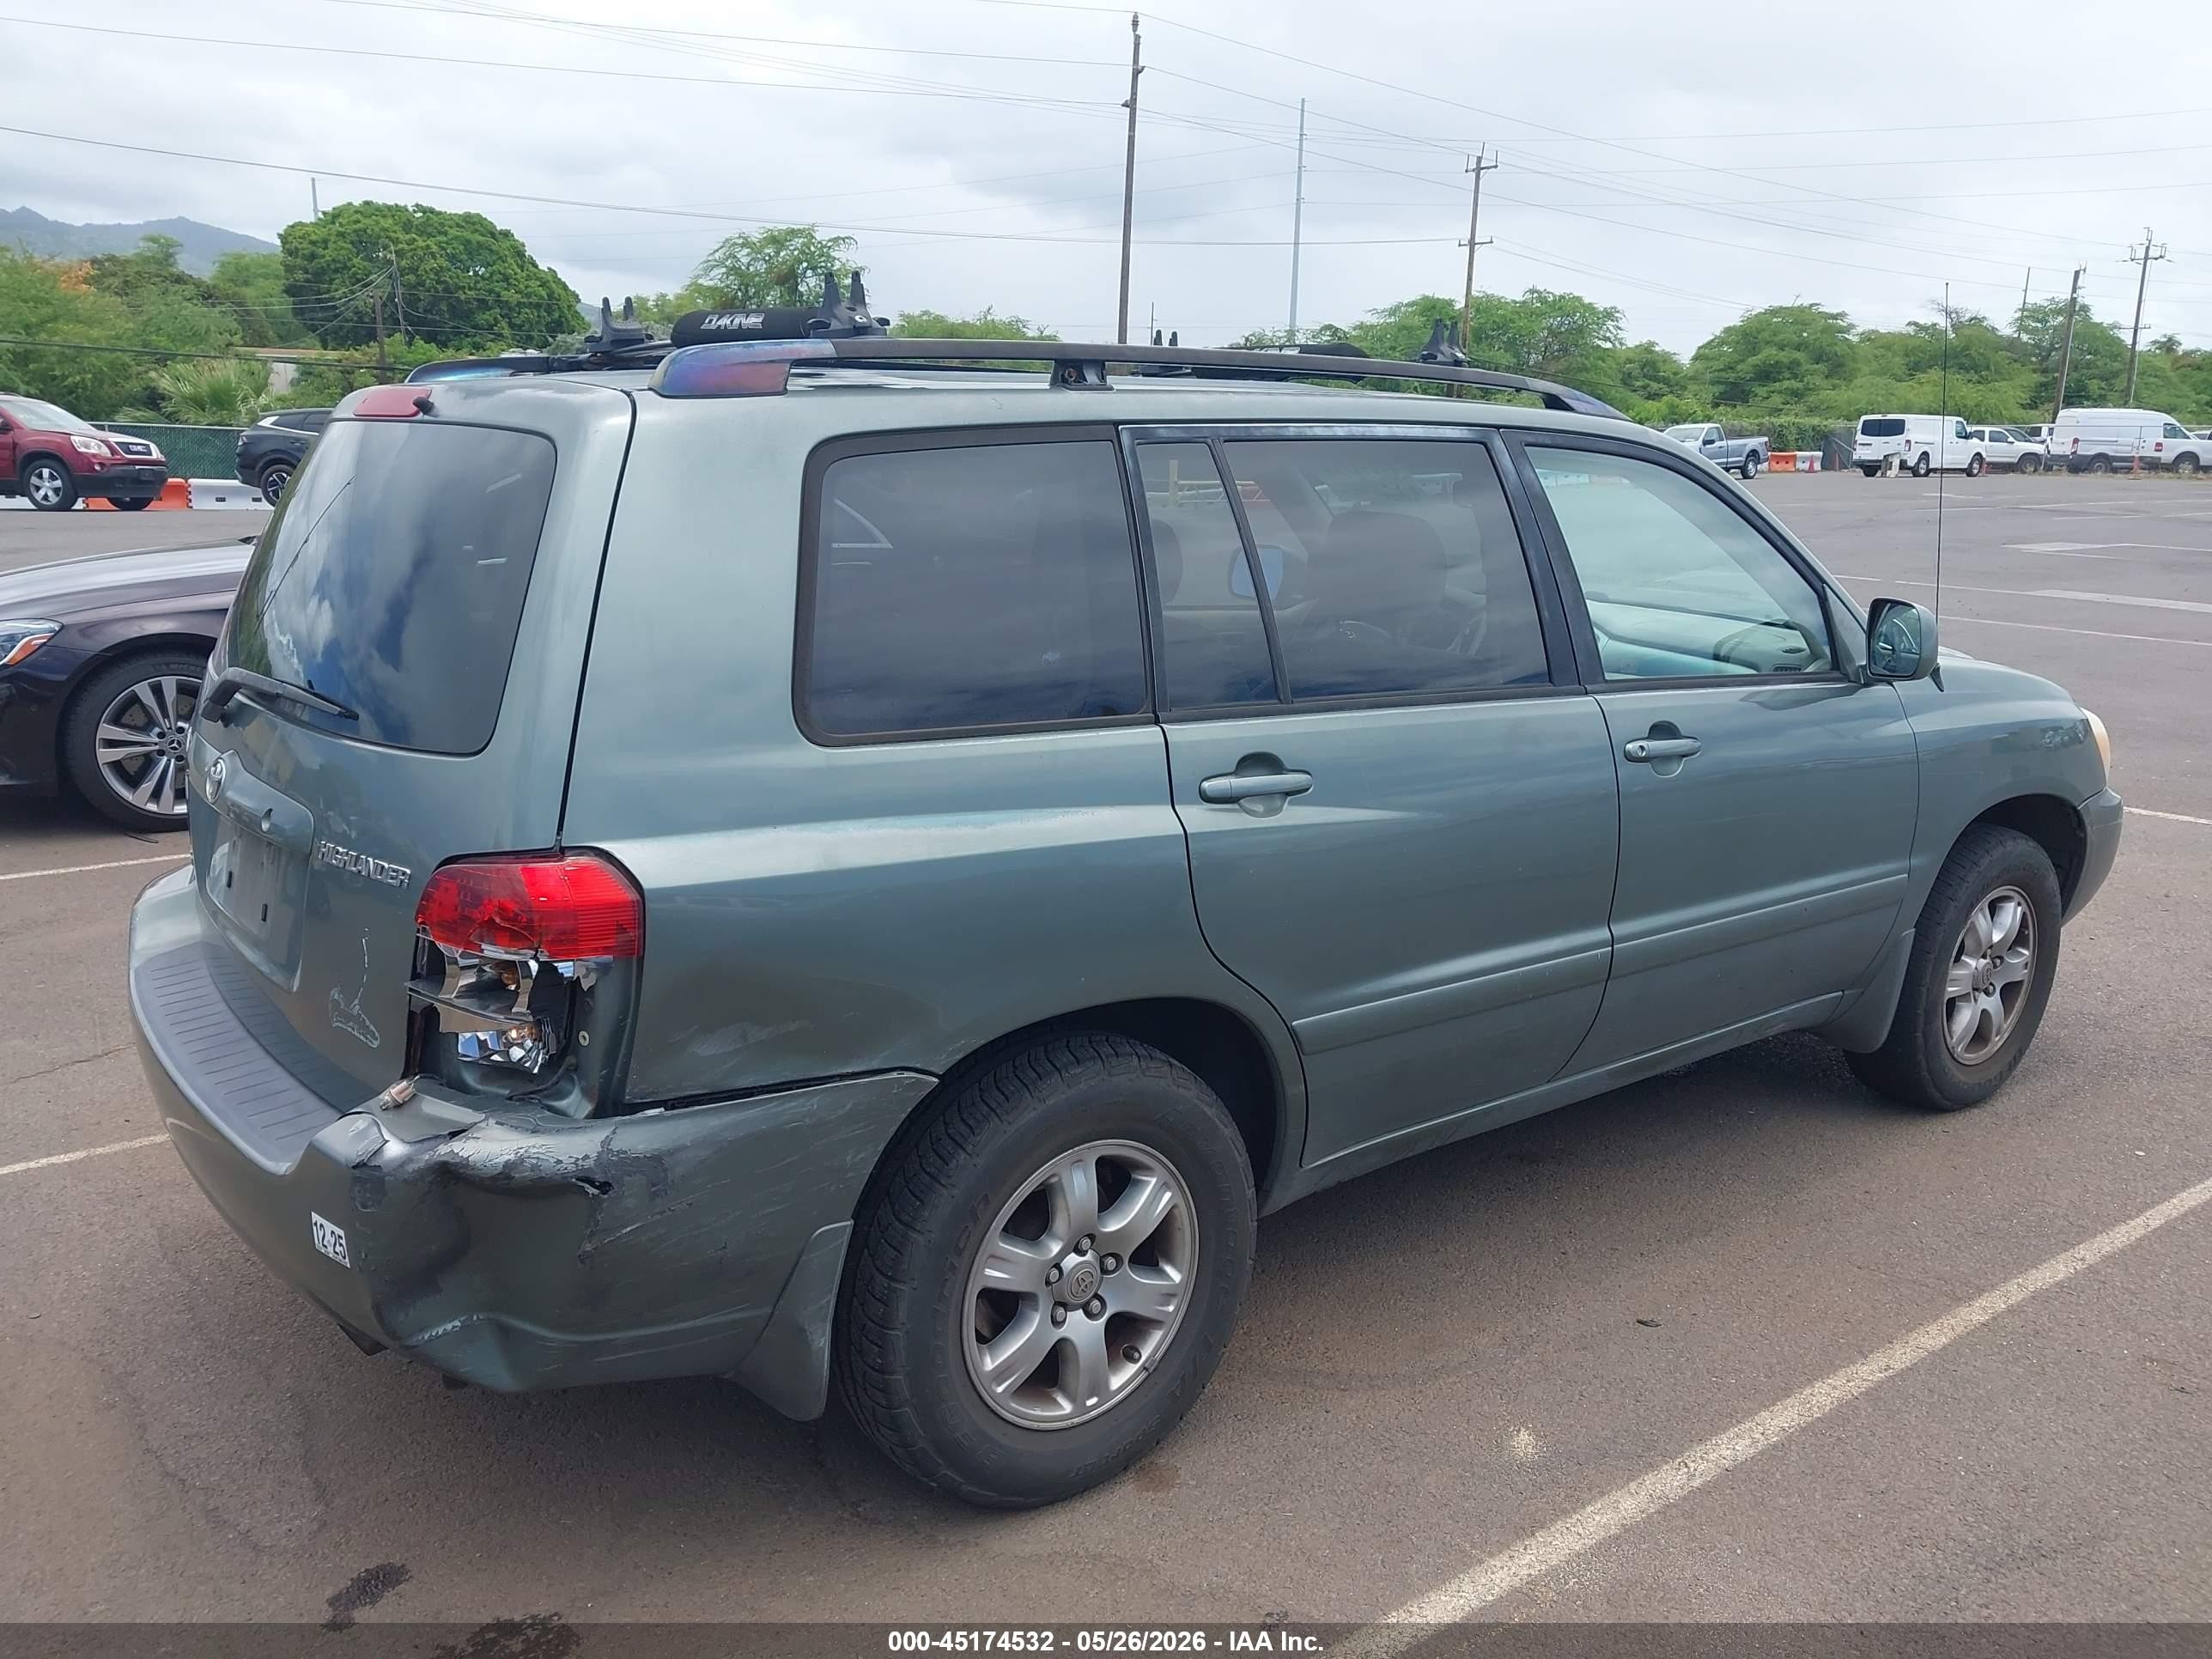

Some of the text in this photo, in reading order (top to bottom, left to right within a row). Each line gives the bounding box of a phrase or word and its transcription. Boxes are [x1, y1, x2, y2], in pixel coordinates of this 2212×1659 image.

[700, 313, 765, 330] DAKINE
[317, 840, 412, 890] HIGHLANDER
[313, 1219, 328, 1249] 12
[331, 1229, 347, 1261] 25
